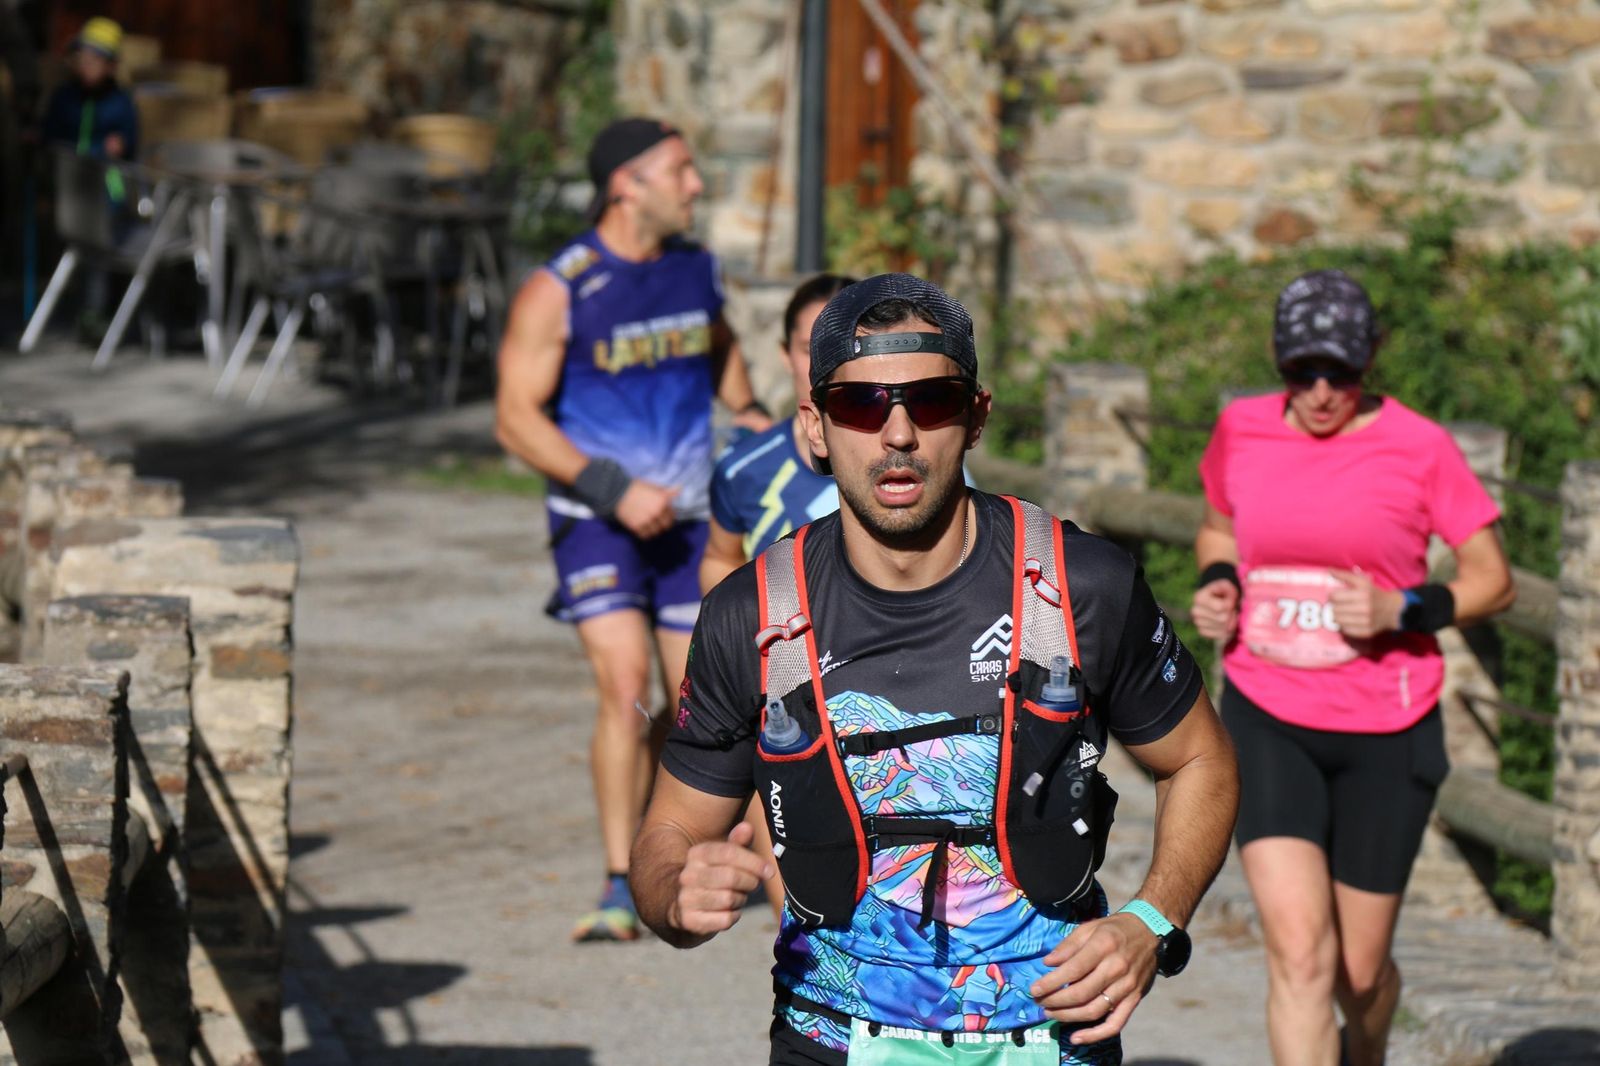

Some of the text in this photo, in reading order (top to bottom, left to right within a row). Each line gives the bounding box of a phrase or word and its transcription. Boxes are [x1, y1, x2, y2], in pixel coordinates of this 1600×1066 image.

[969, 660, 1003, 675] CARAS
[971, 673, 1002, 683] SKY
[880, 1026, 924, 1040] CARAS
[1023, 1029, 1051, 1043] ACE
